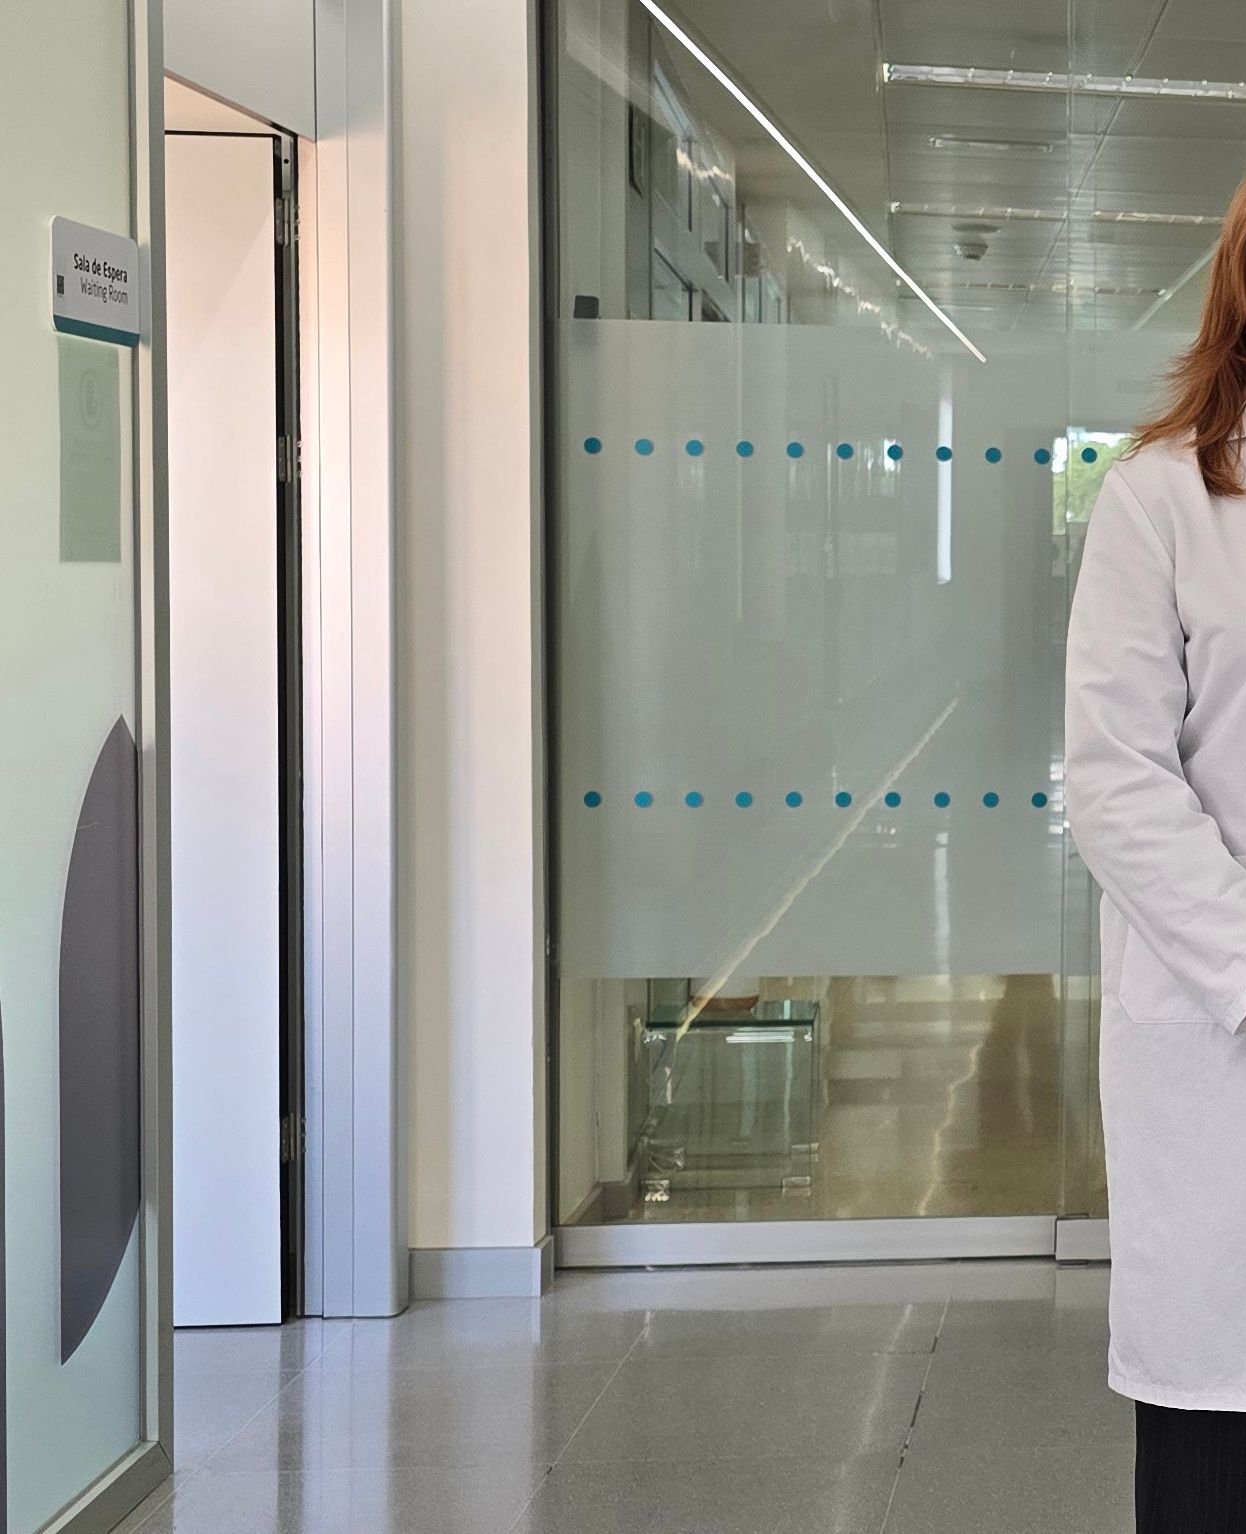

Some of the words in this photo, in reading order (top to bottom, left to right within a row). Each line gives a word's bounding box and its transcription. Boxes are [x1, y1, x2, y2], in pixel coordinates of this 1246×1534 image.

[74, 252, 90, 273] Sala
[92, 257, 102, 276] de
[103, 261, 128, 283] Espera
[80, 276, 107, 304] Waiting
[109, 284, 129, 305] Room
